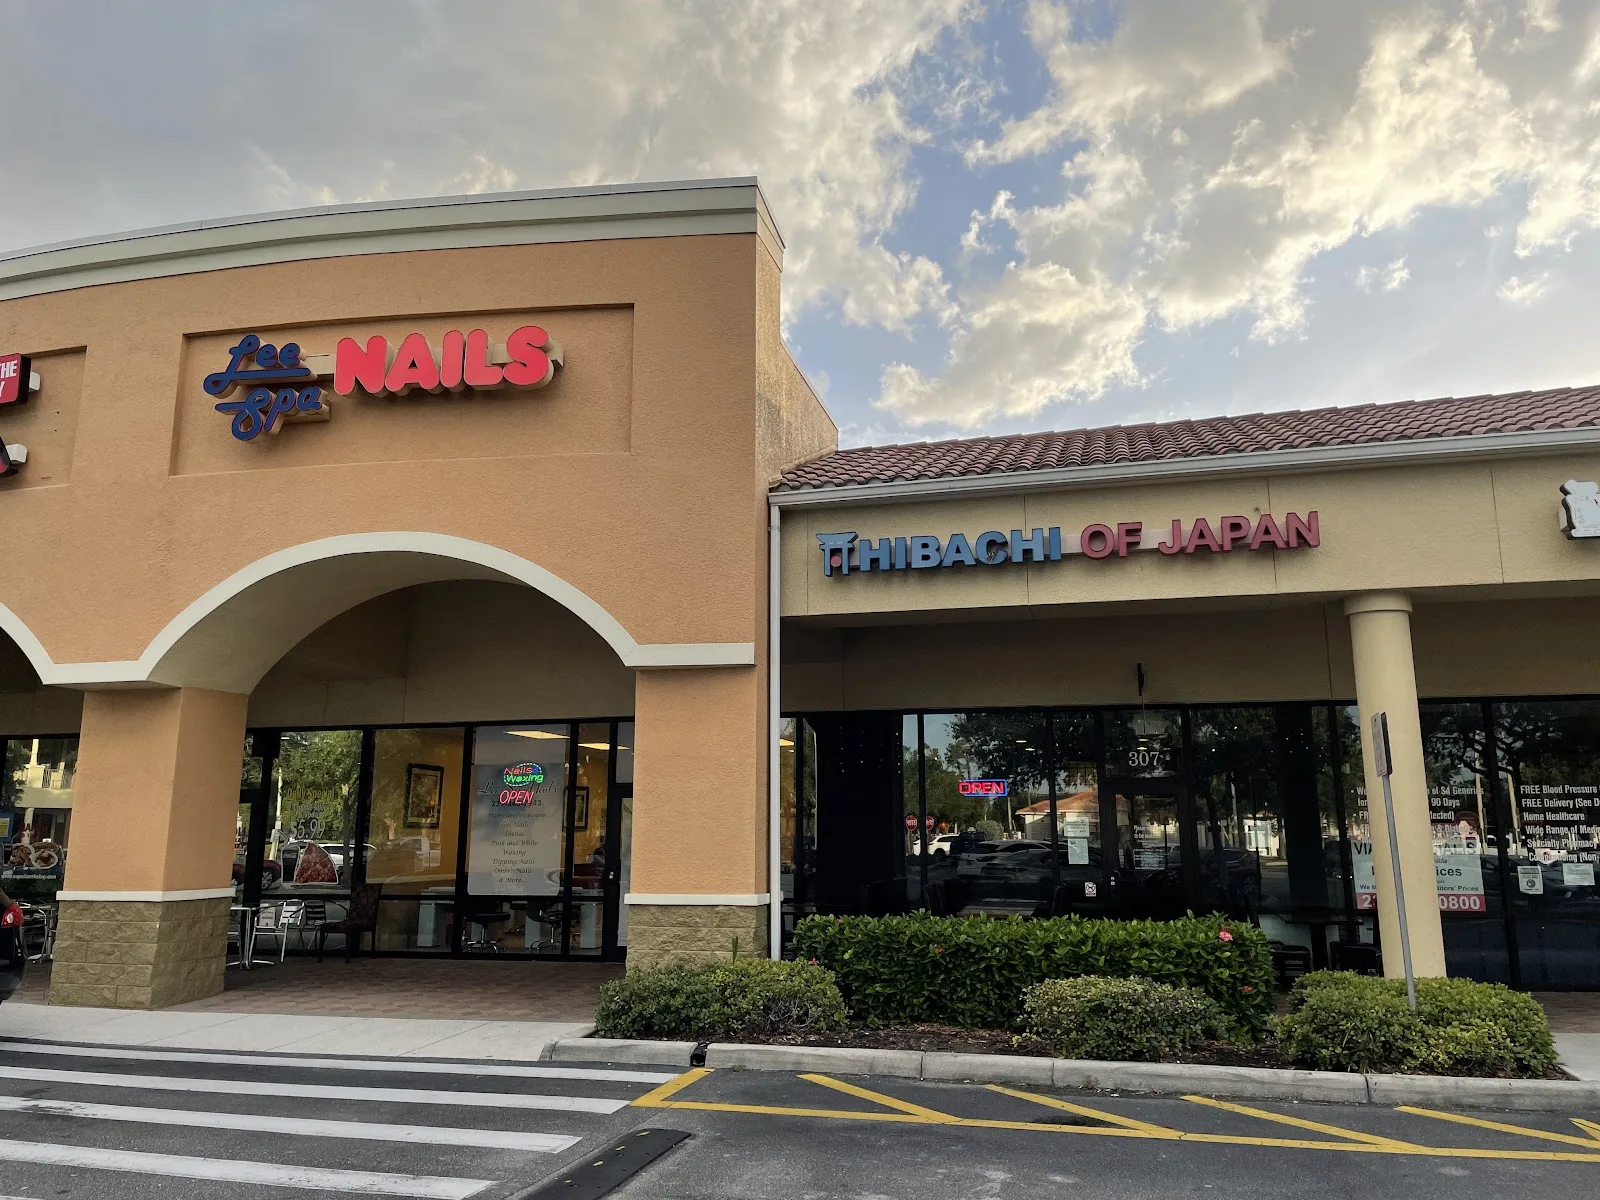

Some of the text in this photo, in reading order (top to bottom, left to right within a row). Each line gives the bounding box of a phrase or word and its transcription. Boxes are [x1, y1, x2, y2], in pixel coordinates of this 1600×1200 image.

[203, 334, 312, 396] Lee
[333, 325, 552, 395] NAILS
[0, 360, 17, 378] HE
[214, 385, 323, 441] Spa
[859, 510, 1320, 572] HIBACHI OF JAPAN
[504, 767, 533, 775] Nails
[506, 774, 544, 784] Waxing
[958, 781, 1004, 795] OPEN
[1520, 785, 1597, 794] FREE Blood Pressure
[499, 790, 534, 804] OPEN
[1443, 798, 1460, 808] Days
[1522, 798, 1542, 807] FREE
[1544, 798, 1573, 808] Delivery
[1575, 798, 1592, 808] (See
[1523, 812, 1585, 821] Home Healthcare
[1525, 825, 1544, 835] Wide
[1546, 825, 1569, 835] Range
